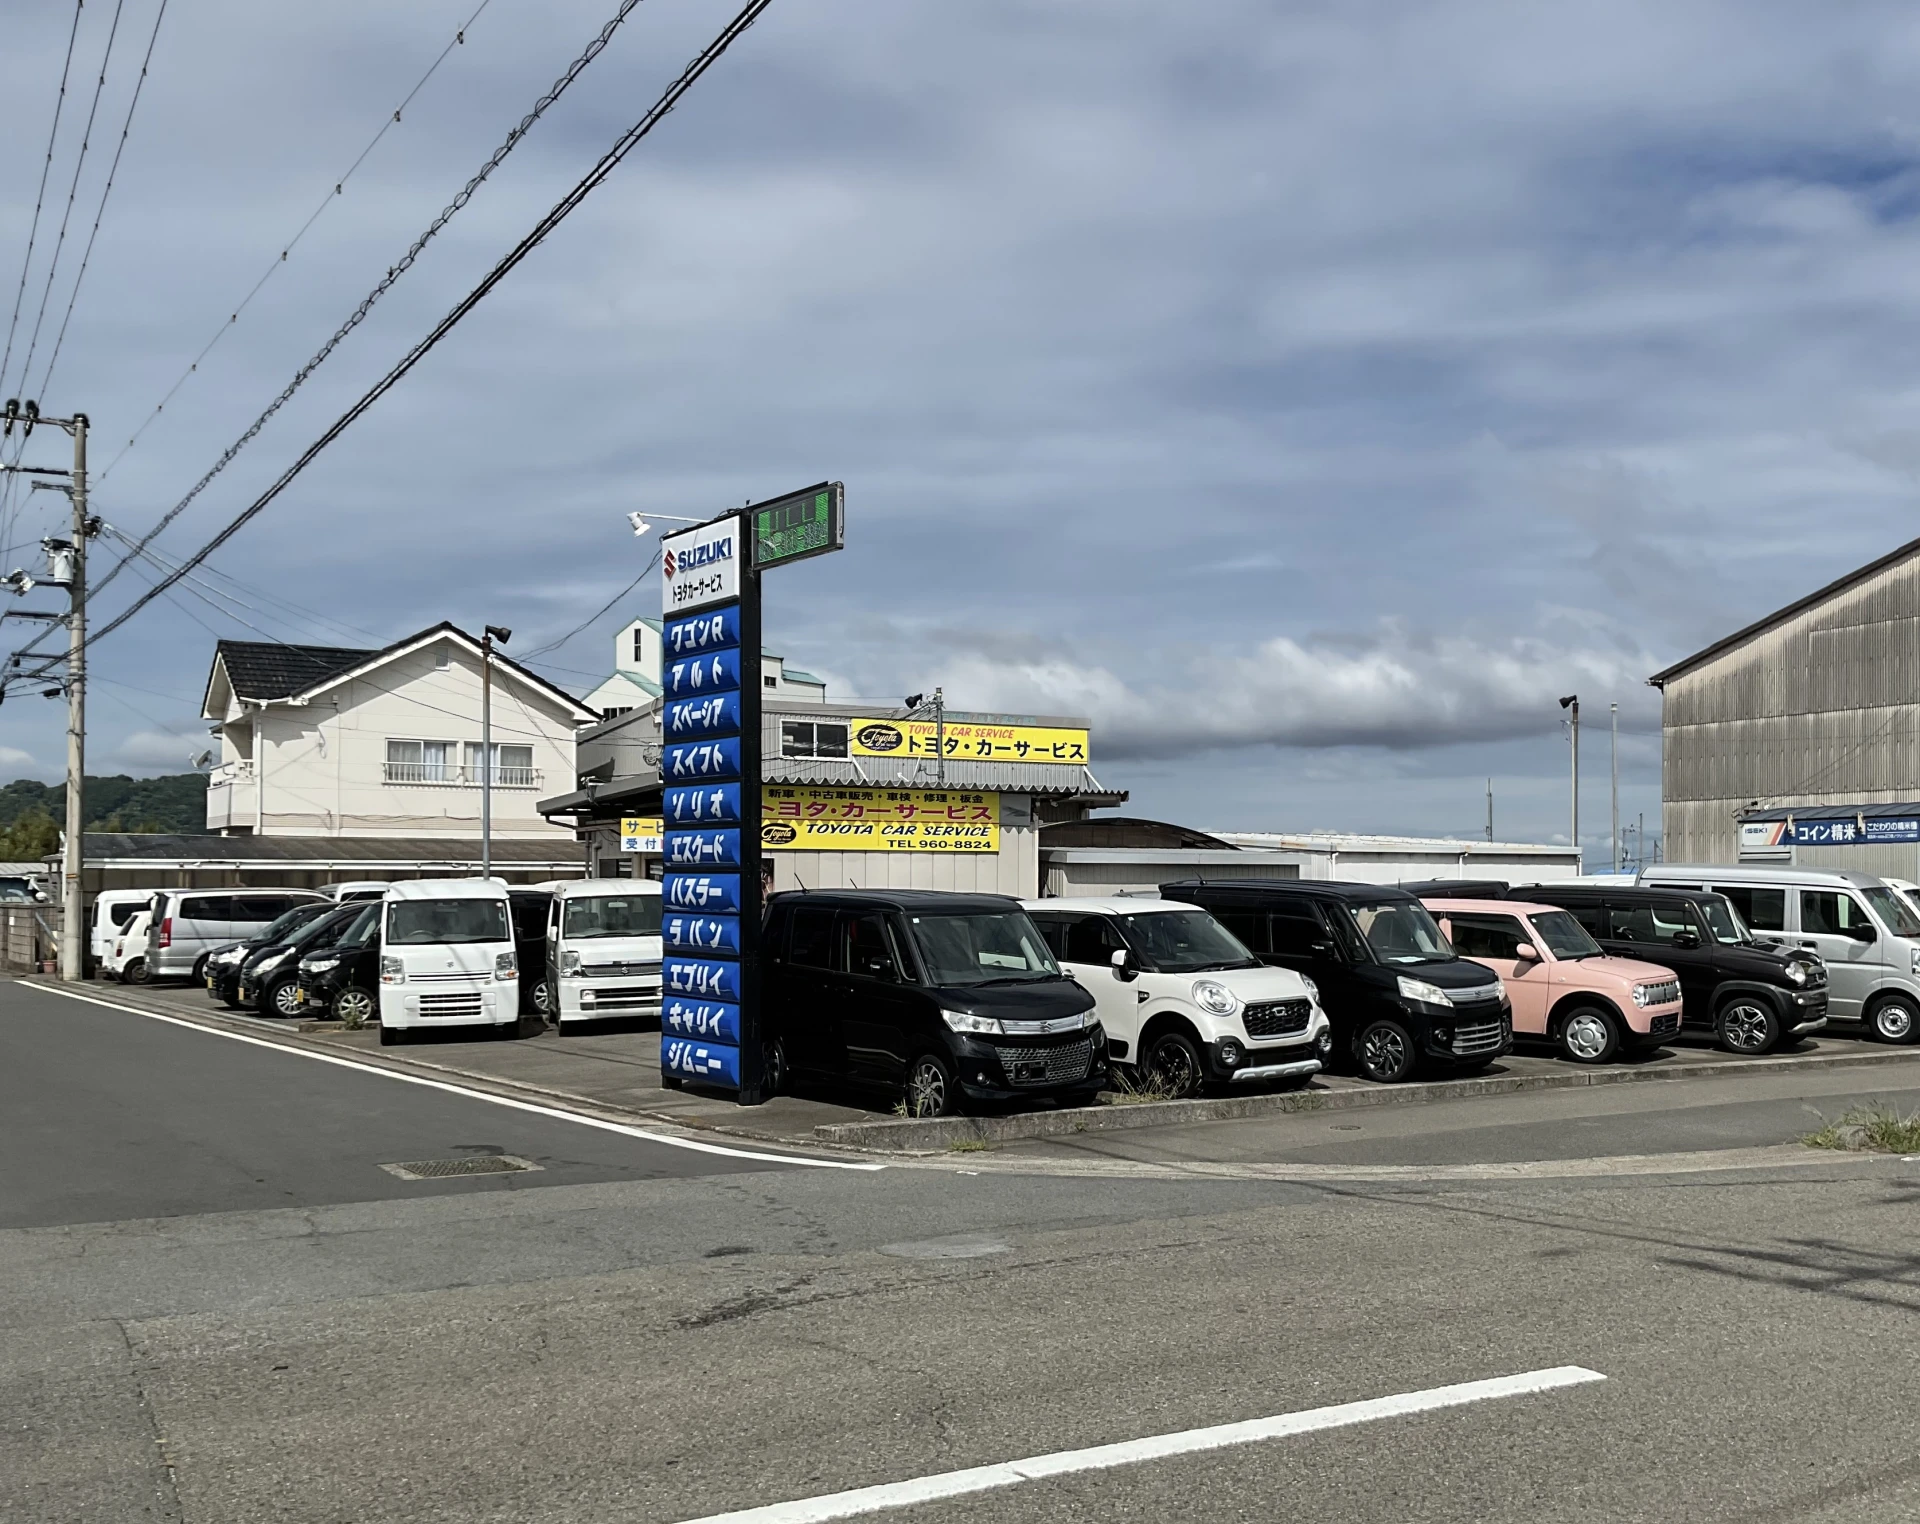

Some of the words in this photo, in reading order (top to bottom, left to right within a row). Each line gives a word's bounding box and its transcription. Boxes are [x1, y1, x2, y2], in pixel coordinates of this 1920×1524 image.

[678, 537, 732, 572] SUZUKI
[672, 574, 723, 604] トヨタカーサービス
[670, 615, 724, 652] ワゴンR
[671, 656, 723, 692] アルト
[671, 698, 725, 731] スペーシア
[909, 725, 947, 735] TOYOA
[951, 727, 971, 737] CAR
[974, 729, 1015, 739] SERVICE
[909, 735, 1085, 759] トヨタ・カーサービス
[672, 743, 723, 775] スイフト
[672, 788, 724, 819] ソリオ
[626, 837, 657, 850] 受付
[806, 824, 874, 835] TOYOTA
[881, 825, 917, 835] CAR
[923, 826, 992, 837] SERVICE
[886, 839, 916, 848] TEL
[919, 840, 992, 849] 960-8824
[1798, 823, 1856, 841] コイン精米
[671, 834, 725, 863] エスクード
[670, 877, 723, 906] ハスラー
[669, 918, 723, 949] ラパン
[670, 963, 724, 996] エブリイ
[668, 1042, 722, 1074] ジムニー
